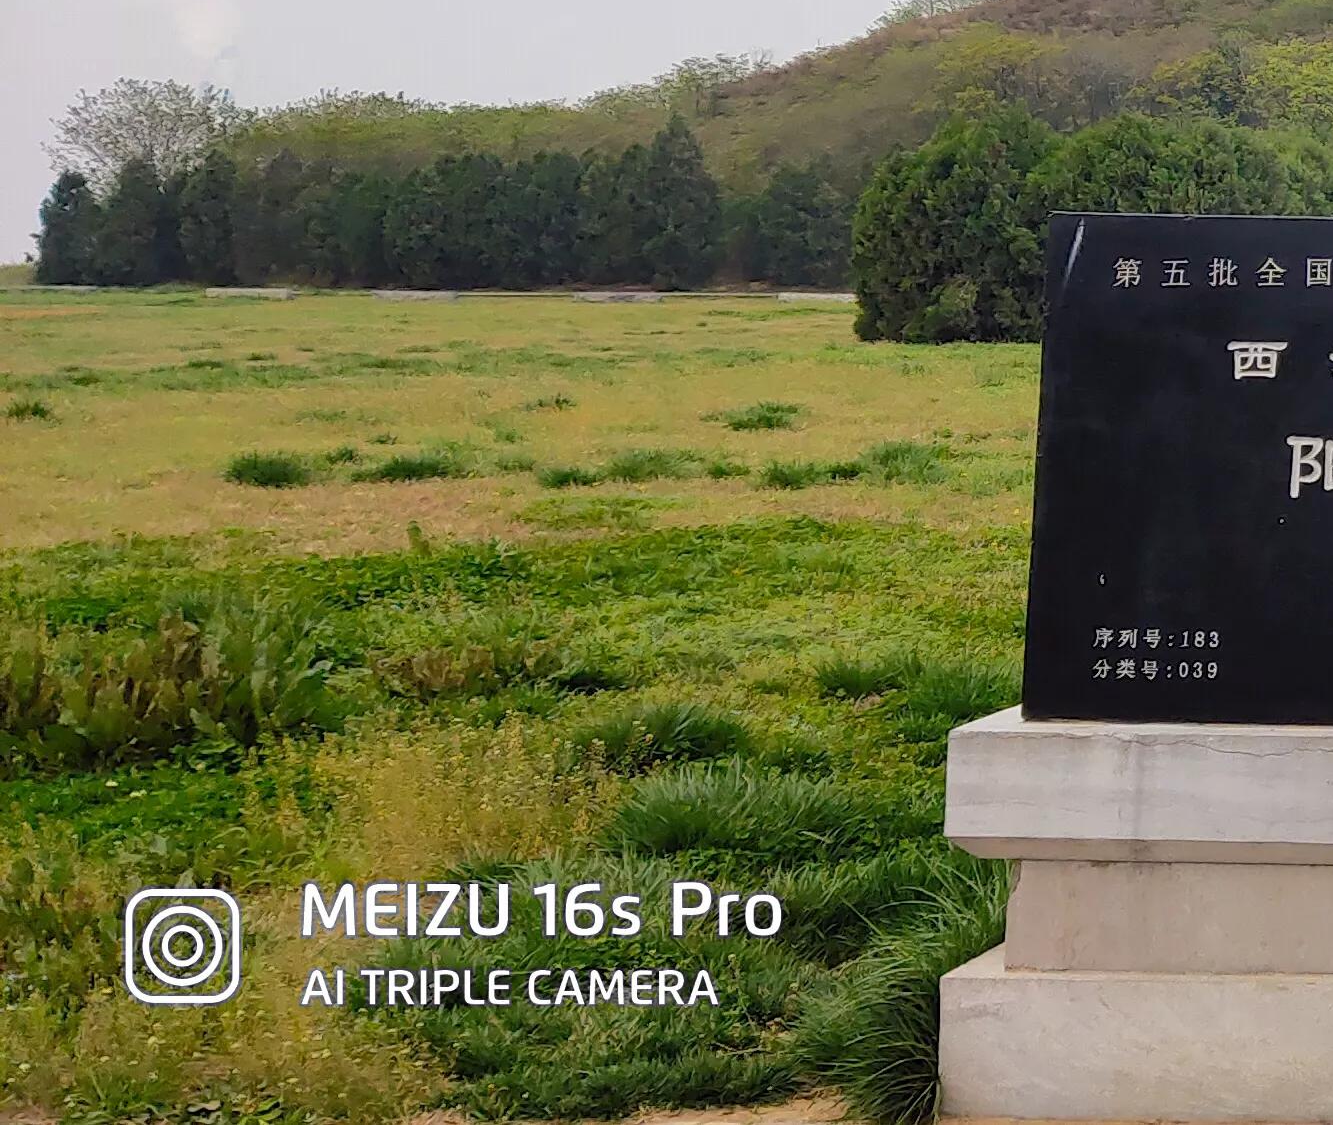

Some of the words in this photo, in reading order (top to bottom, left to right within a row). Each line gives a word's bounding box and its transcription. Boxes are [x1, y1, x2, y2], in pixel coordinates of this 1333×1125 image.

[1092, 627, 1220, 649] 序列号:183
[1092, 658, 1218, 680] 分类号:039
